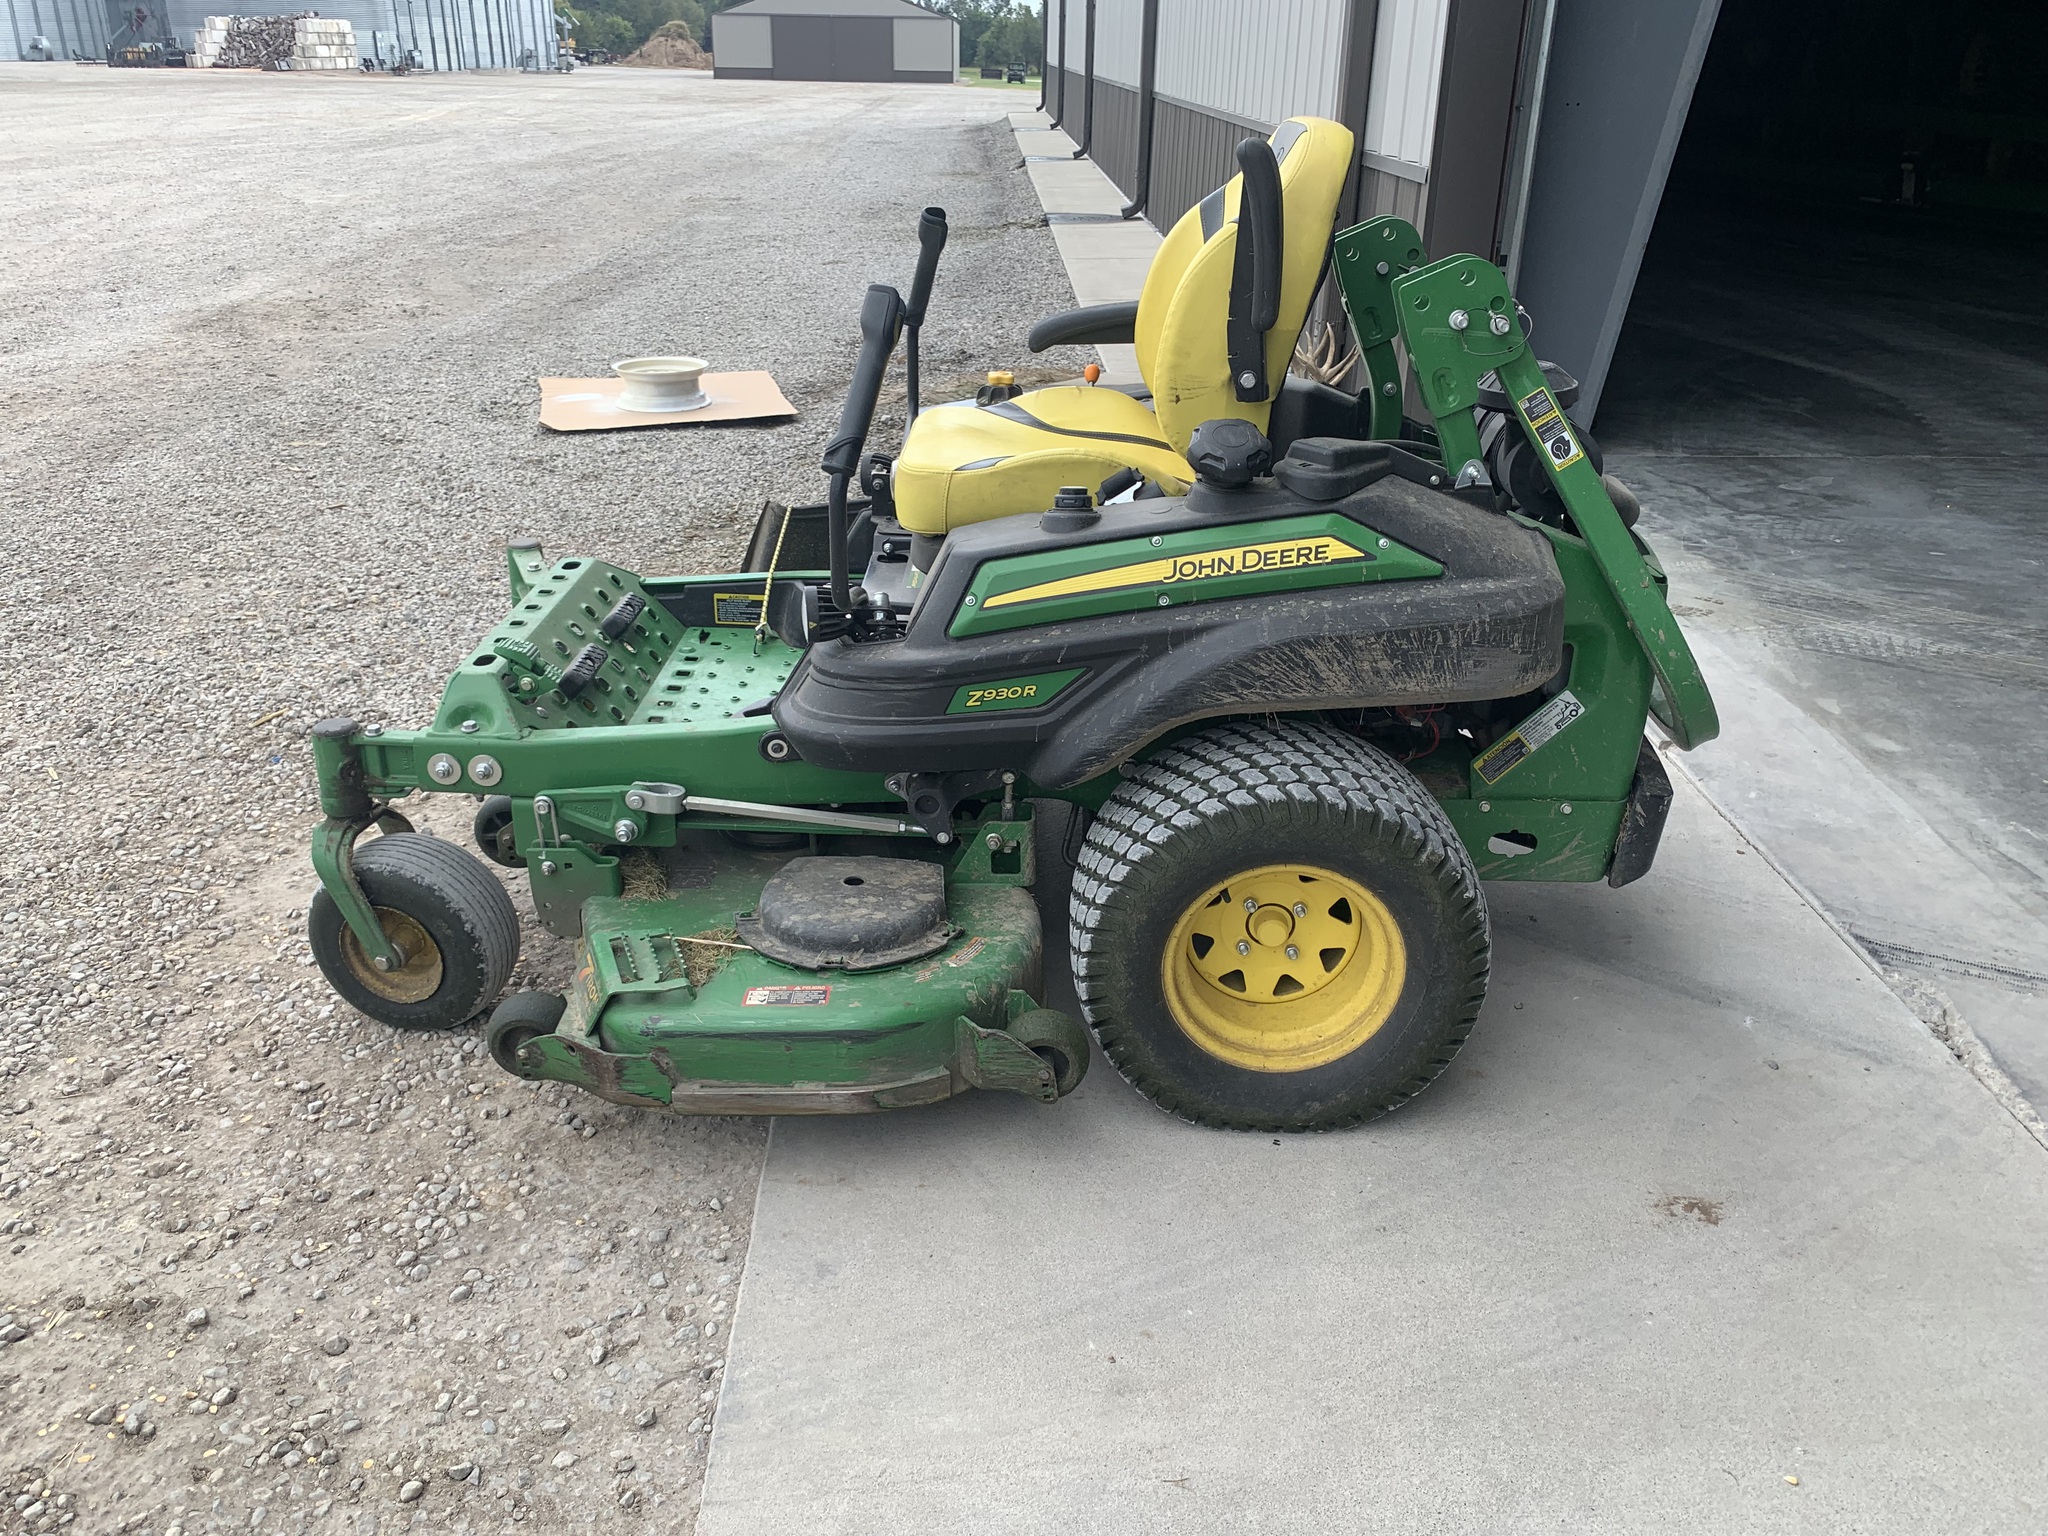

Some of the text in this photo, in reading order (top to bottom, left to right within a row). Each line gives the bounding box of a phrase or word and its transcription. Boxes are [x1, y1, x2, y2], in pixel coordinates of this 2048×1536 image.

[1163, 544, 1330, 581] JOHN DEERE
[965, 685, 1037, 707] Z930R
